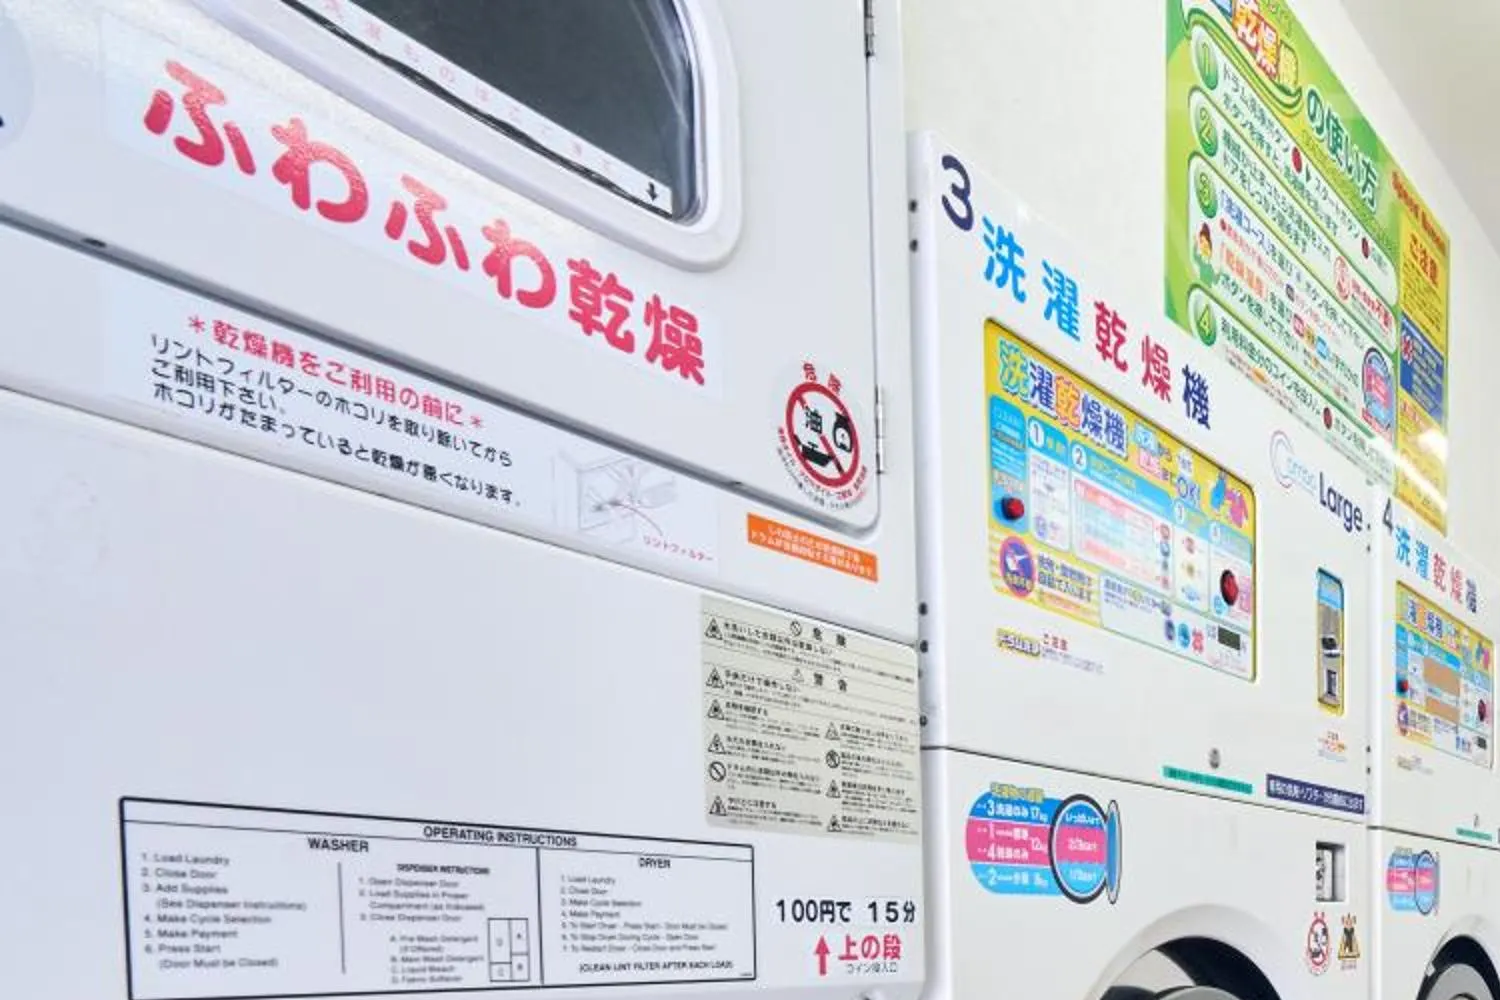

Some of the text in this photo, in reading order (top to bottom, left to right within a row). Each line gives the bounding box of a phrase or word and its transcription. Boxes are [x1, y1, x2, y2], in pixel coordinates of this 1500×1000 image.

[941, 155, 974, 231] 3
[143, 59, 706, 387] ふわふわ乾燥
[980, 214, 1212, 431] 洗濯乾燥機
[151, 358, 287, 414] ご利用下さい。
[999, 337, 1128, 461] 洗濯乾燥機
[804, 405, 823, 434] 油
[153, 382, 521, 507] ホコリがたまっていると乾燥が悪くなります。
[1319, 472, 1363, 532] Large
[1382, 497, 1395, 536] 4
[307, 837, 370, 853] WASHER
[423, 825, 577, 847] OPERATING INSTRUCTIONS
[154, 853, 230, 867] Load Laundry
[439, 865, 491, 876] INSTRUCTIONS
[638, 857, 671, 869] DRYER
[155, 868, 218, 880] Close Door
[155, 883, 229, 896] Add Supplies
[186, 899, 240, 912] Dispenser
[776, 899, 916, 924] 100円で 15分
[157, 914, 187, 924] Make
[189, 914, 220, 927] Cycle
[157, 929, 239, 941] Make Payment
[158, 943, 221, 954] Press Start
[838, 934, 902, 961] 上の段
[193, 958, 220, 969] Must
